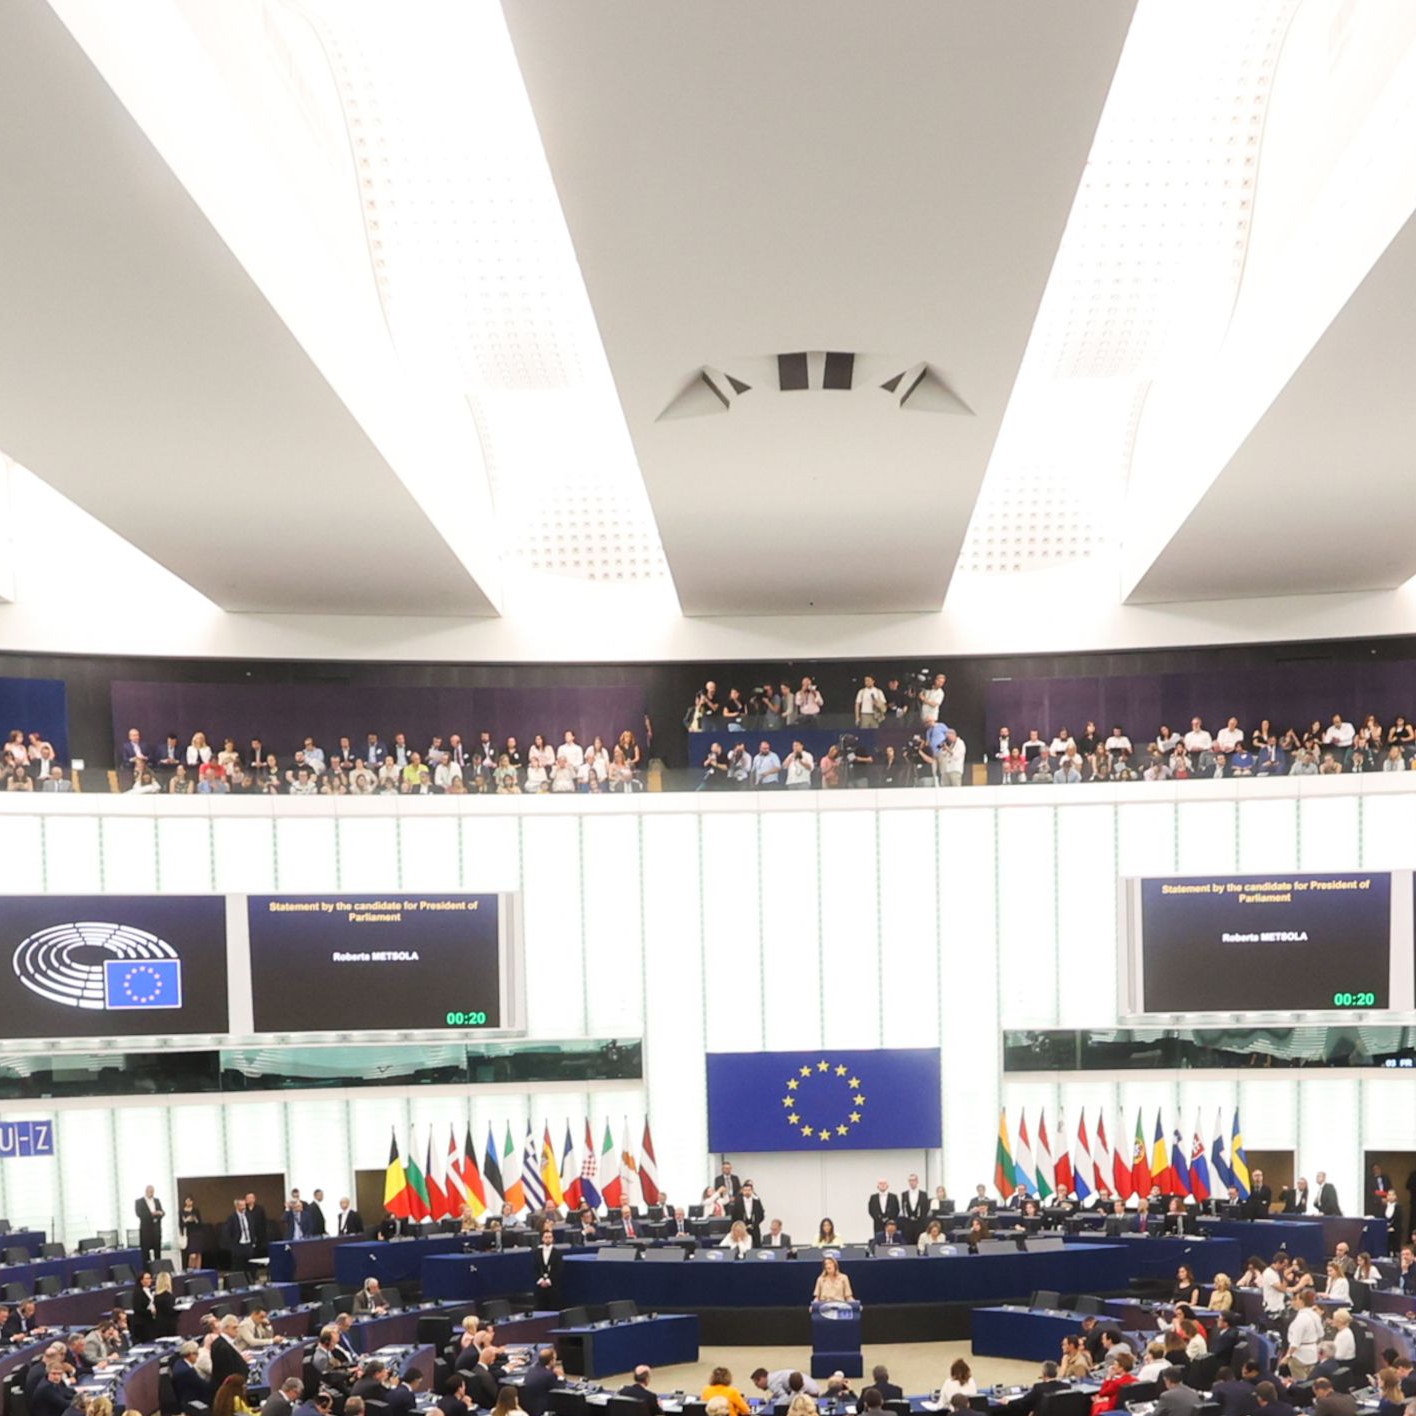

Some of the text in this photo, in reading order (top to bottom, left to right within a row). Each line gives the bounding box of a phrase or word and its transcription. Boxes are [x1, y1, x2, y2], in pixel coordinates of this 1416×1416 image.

[1162, 879, 1370, 894] Statement by the candidate for President of
[1239, 893, 1291, 903] Parliament
[269, 900, 478, 913] Statement by the candidate for President of
[349, 913, 401, 922] Parliament
[1222, 931, 1308, 943] Roberta METSOLA
[333, 951, 419, 961] Roberta METSOLA
[1334, 993, 1375, 1006] 00:20
[446, 1012, 486, 1025] 00:20
[1385, 1058, 1413, 1067] 03 FR
